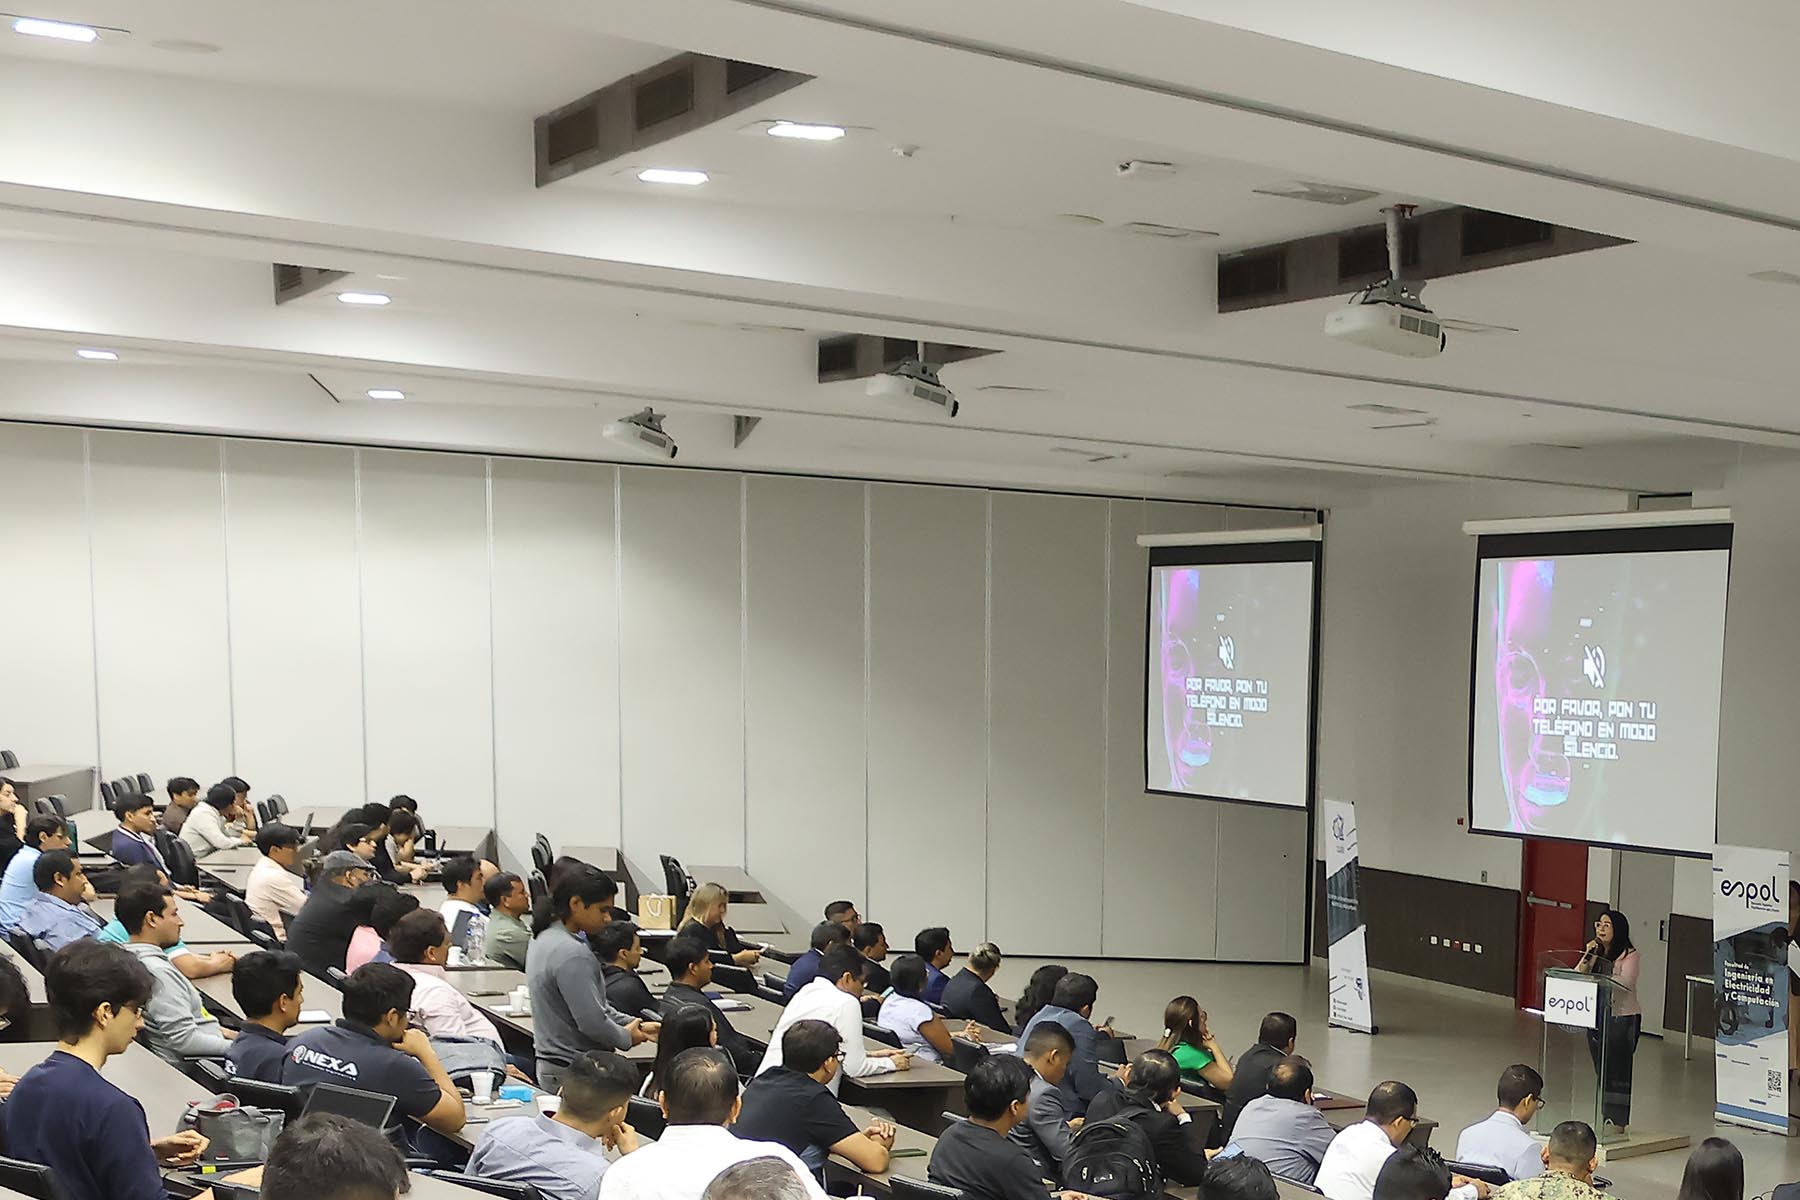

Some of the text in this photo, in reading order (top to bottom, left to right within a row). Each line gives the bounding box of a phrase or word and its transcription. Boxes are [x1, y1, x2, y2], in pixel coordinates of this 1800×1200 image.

[1186, 678, 1202, 691] POR
[1236, 680, 1252, 693] PON
[1256, 680, 1268, 694] TU
[1229, 696, 1240, 710] EN
[1243, 697, 1267, 712] MODO
[1534, 698, 1656, 720] POR FAVOR, PON TU
[1533, 715, 1656, 740] TELÉFONO EN MODO
[1564, 741, 1618, 760] SILENCIO.
[1721, 876, 1779, 908] espol
[1725, 979, 1770, 994] Electricidad
[1549, 996, 1590, 1014] espol
[1725, 991, 1779, 1007] y Computación
[304, 1050, 357, 1075] NEXA
